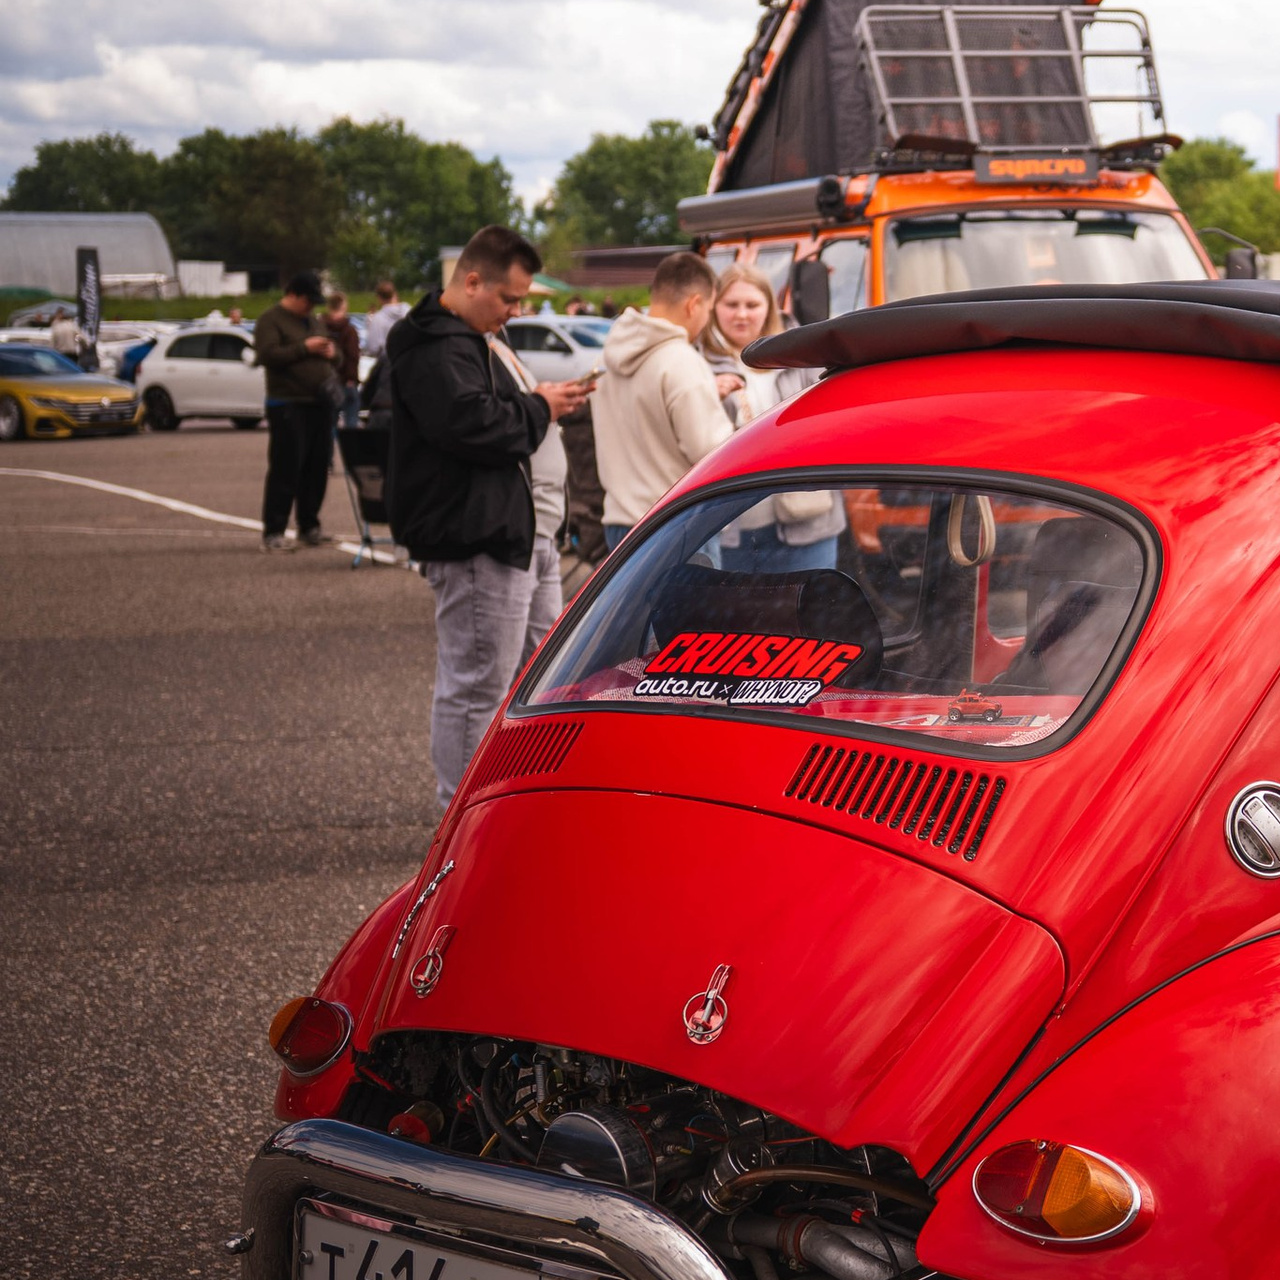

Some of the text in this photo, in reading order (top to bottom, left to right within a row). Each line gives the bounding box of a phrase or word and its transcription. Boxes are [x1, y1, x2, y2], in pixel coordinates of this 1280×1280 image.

[644, 631, 863, 686] CRUISING
[634, 677, 719, 697] auto.ru
[730, 679, 821, 704] WHYNOT?
